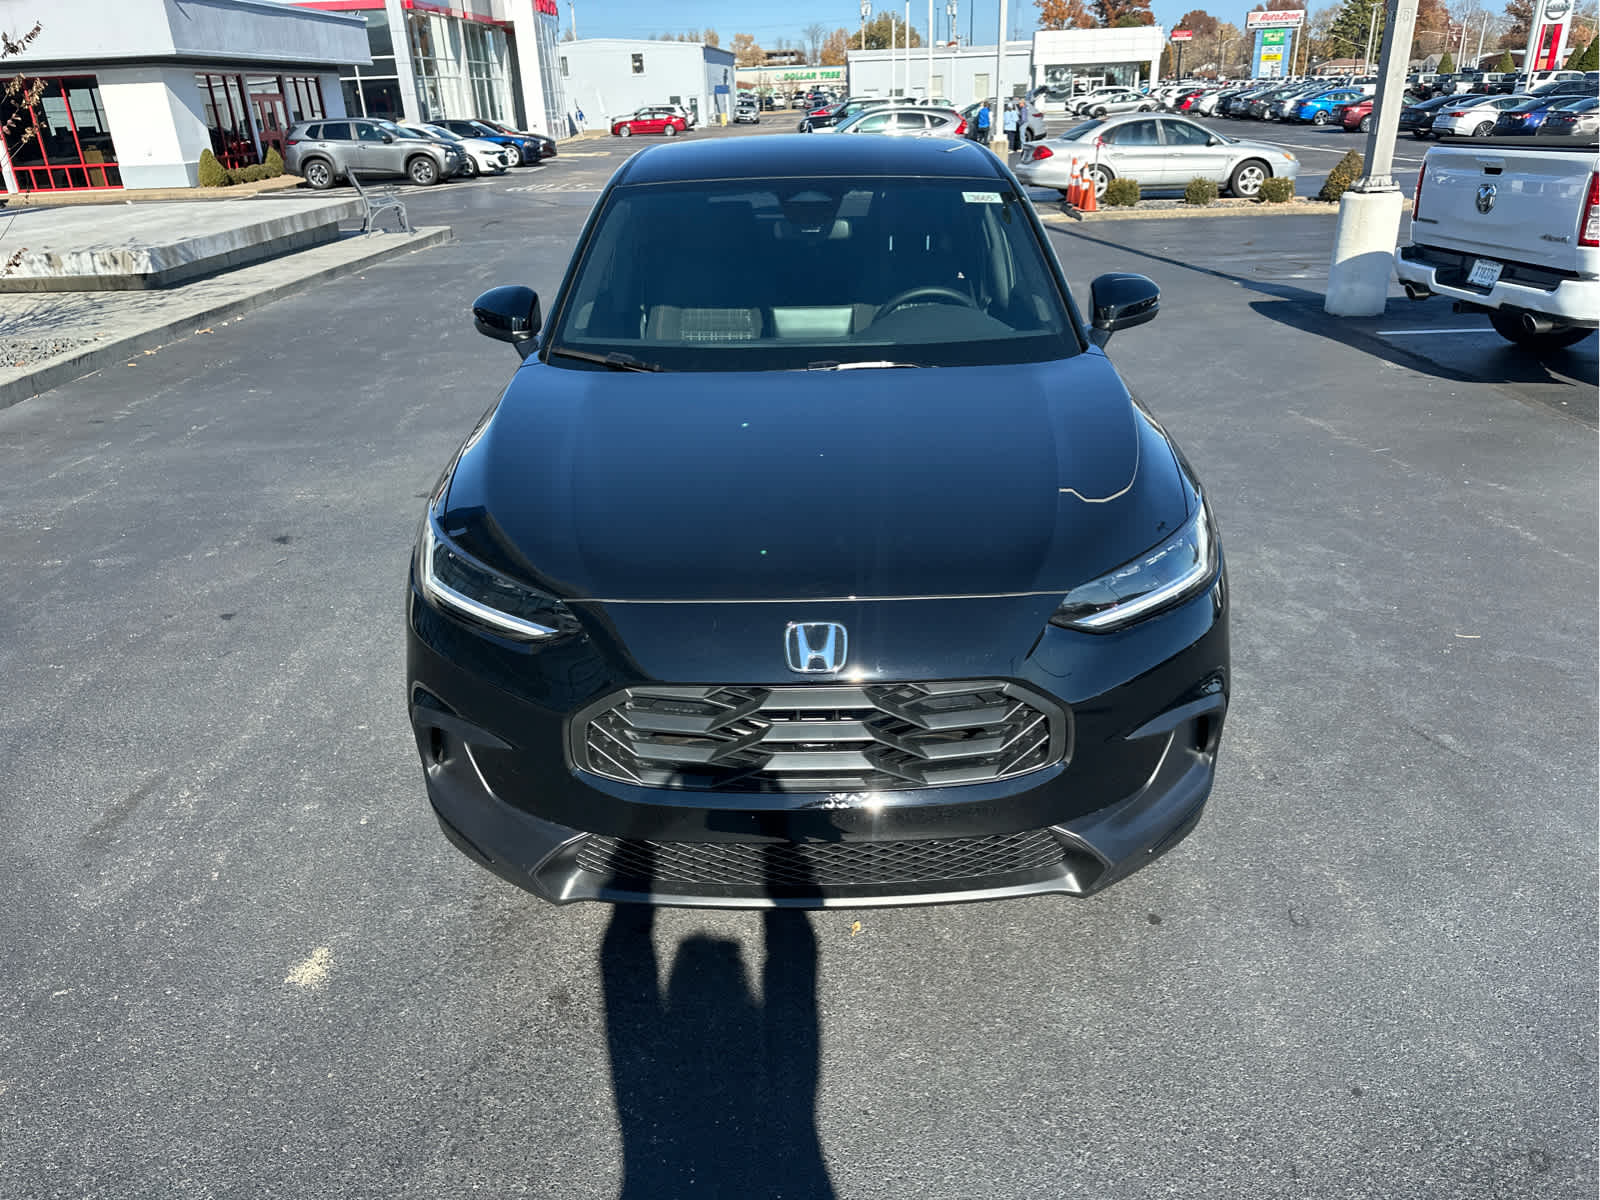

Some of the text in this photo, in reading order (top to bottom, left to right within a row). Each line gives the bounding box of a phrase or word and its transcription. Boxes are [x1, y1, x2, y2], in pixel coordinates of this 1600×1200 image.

[1260, 12, 1300, 21] AutoZone
[784, 71, 840, 81] DOLLAR TREE
